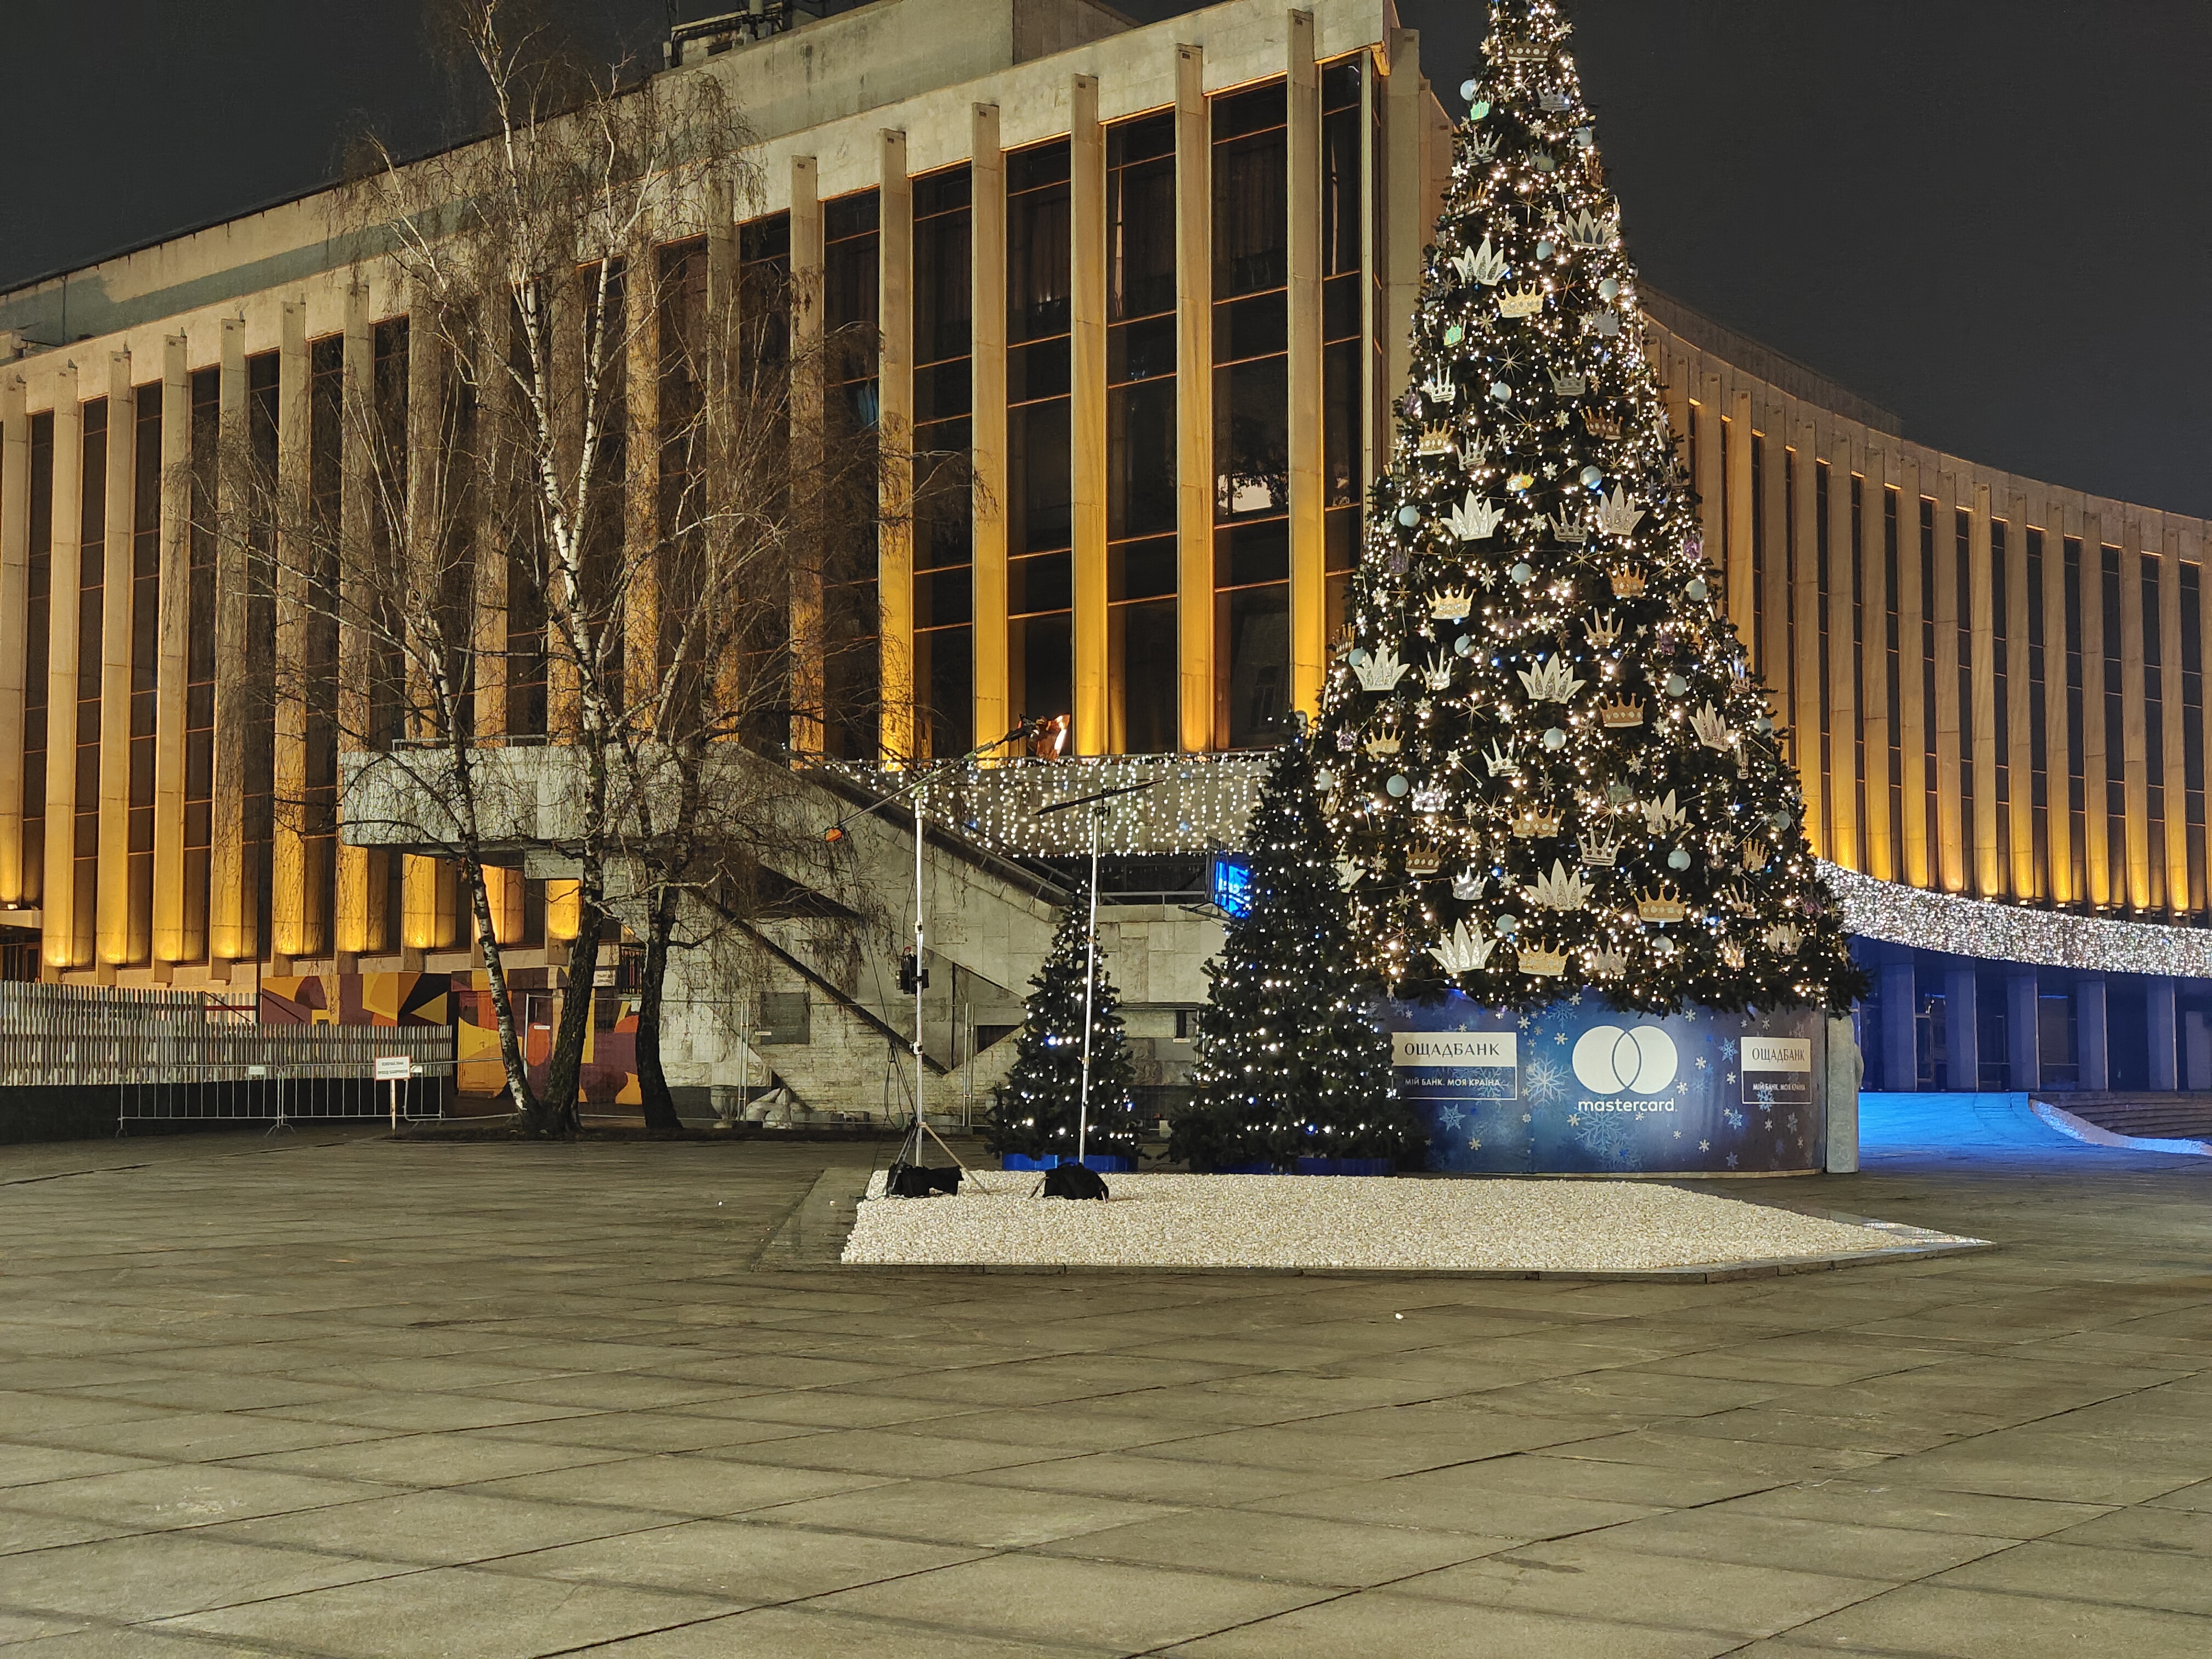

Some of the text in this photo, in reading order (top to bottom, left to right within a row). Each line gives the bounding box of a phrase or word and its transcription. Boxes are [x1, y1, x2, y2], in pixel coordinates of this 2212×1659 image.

[1404, 1043, 1500, 1058] ОЩАДБАНК
[1752, 1048, 1805, 1063] ОЩАДБАНК
[1405, 1076, 1420, 1086] МІЙ
[1447, 1078, 1467, 1086] МОЯ
[1469, 1077, 1500, 1086] КРАЇНА
